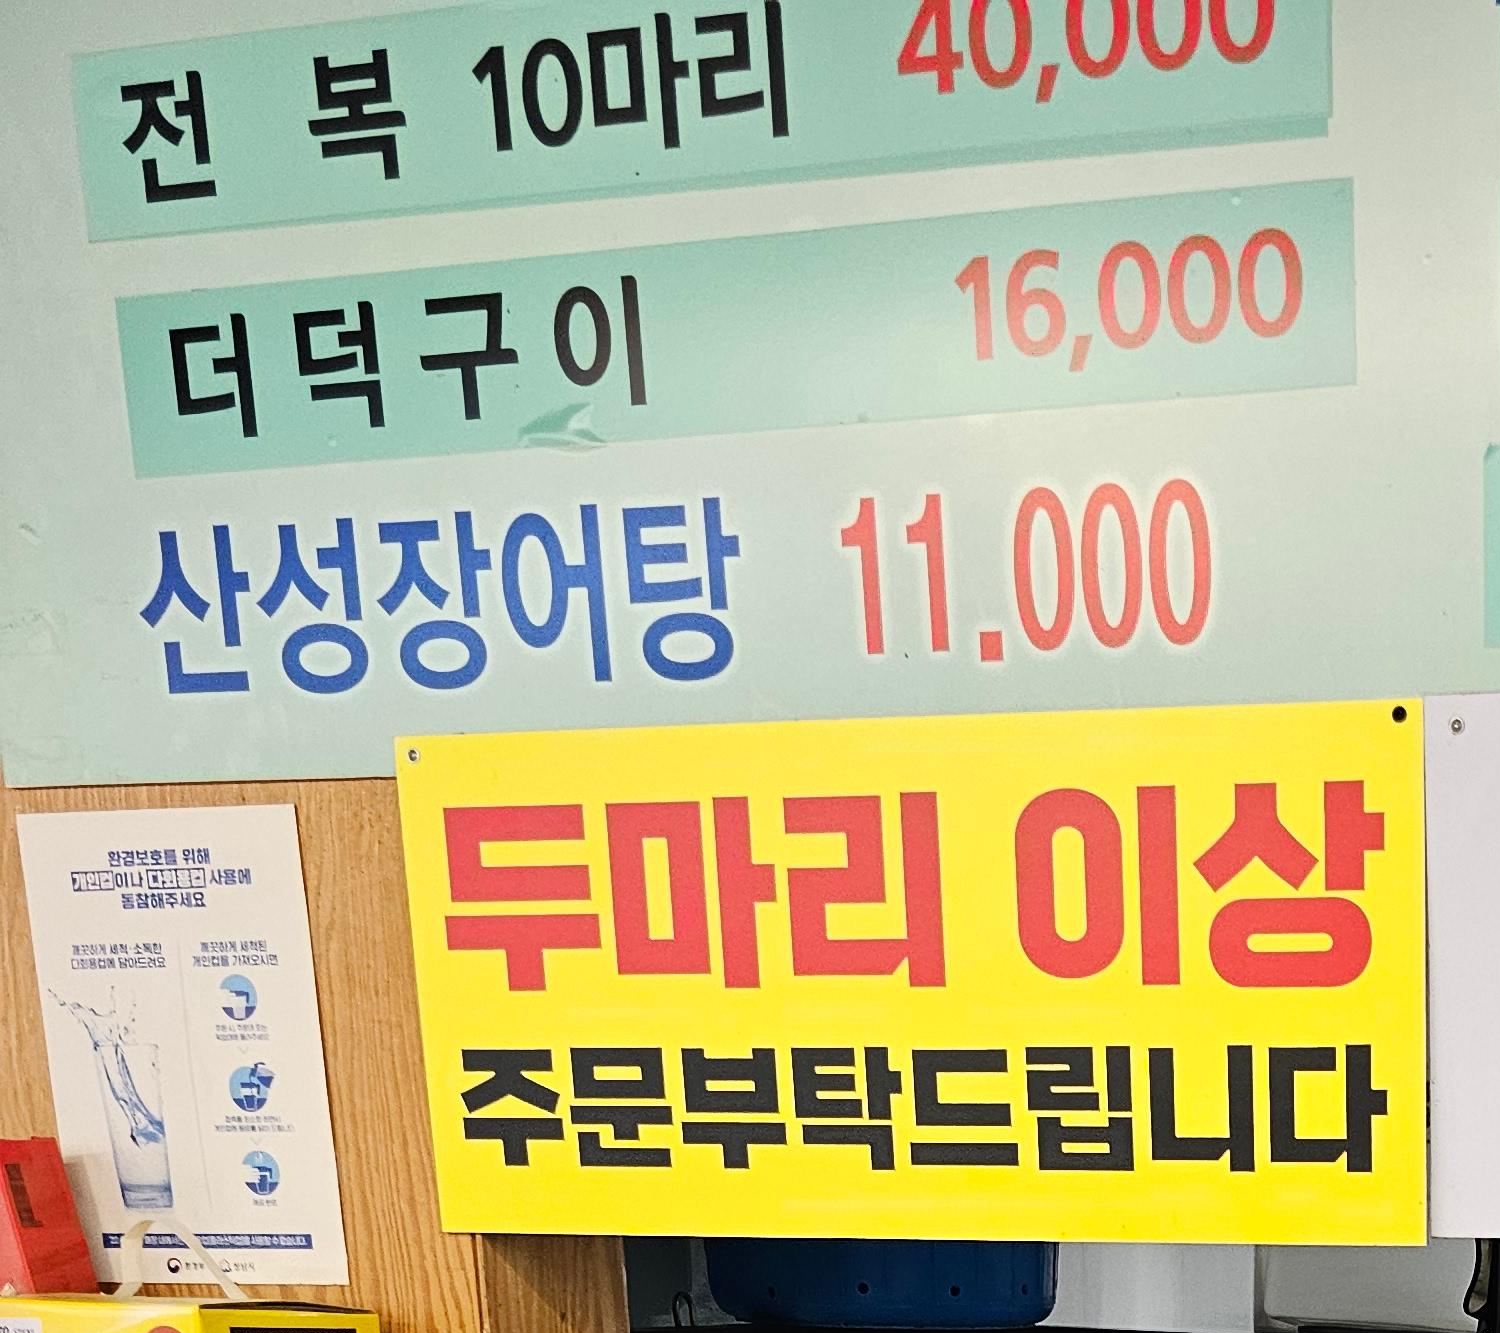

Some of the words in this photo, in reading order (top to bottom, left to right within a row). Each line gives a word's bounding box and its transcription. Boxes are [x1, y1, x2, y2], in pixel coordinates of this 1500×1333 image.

[896, 0, 1276, 104] 40,000
[953, 227, 1303, 374] 16,000
[140, 497, 740, 695] 산성장어탕
[840, 478, 1212, 664] 11.000
[108, 849, 177, 867] 환경보호를
[183, 848, 211, 865] 위해
[121, 892, 207, 909] 동참해주세요
[209, 868, 252, 886] 사용에
[442, 790, 946, 992] 두마리
[1014, 779, 1386, 989] 이상
[460, 1044, 1388, 1173] 주문부탁드립니다
